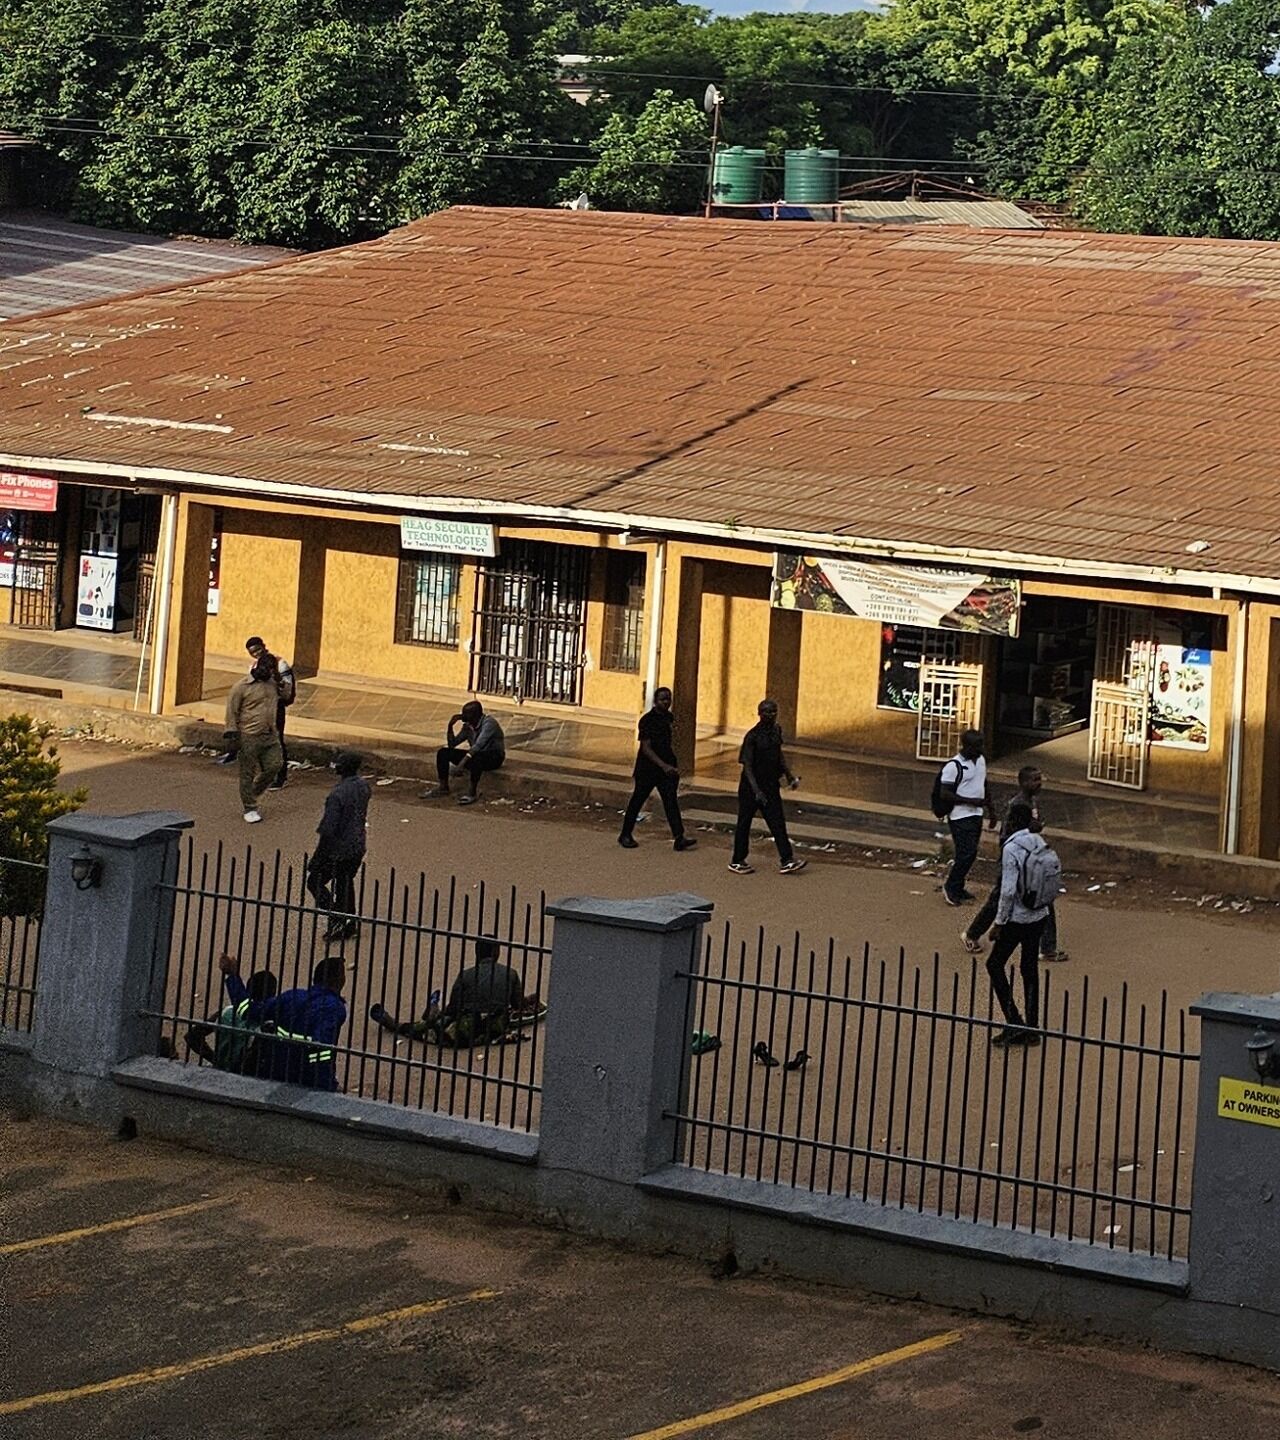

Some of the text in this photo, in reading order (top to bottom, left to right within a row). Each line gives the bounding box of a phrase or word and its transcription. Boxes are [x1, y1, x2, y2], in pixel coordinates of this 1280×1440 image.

[1, 474, 54, 489] Fix Phones
[403, 519, 490, 536] HEAG SECURITY
[407, 530, 488, 547] TECHNOLOGIES
[1223, 1099, 1236, 1111] AT
[1238, 1102, 1280, 1119] OWNERS
